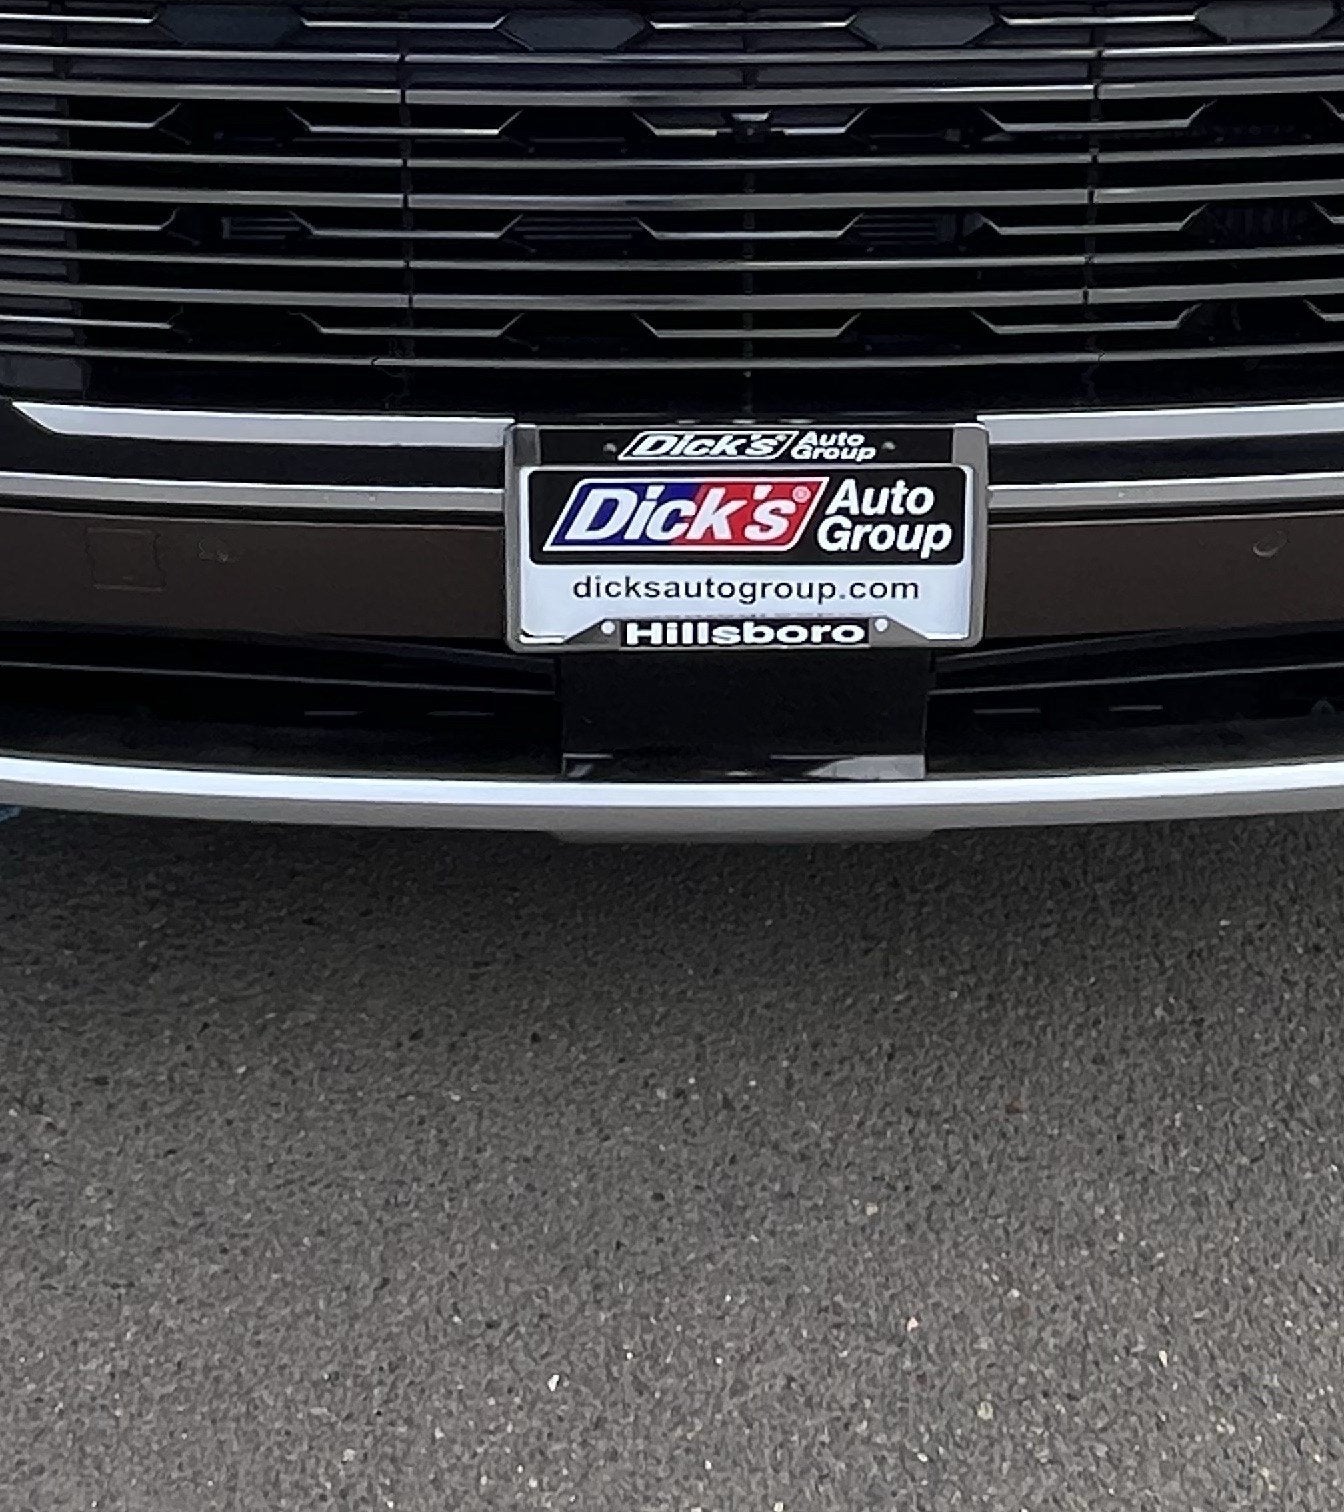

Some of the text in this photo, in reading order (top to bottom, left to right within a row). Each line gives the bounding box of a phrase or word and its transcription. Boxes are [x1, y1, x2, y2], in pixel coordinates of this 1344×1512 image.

[632, 433, 788, 457] Dick's
[795, 431, 865, 447] Auto
[790, 445, 876, 462] Group
[825, 478, 935, 516] Auto
[565, 484, 797, 541] Dick's
[817, 515, 953, 557] Group
[573, 575, 919, 605] dicksautogroup.com
[626, 620, 865, 645] Hillsboro
